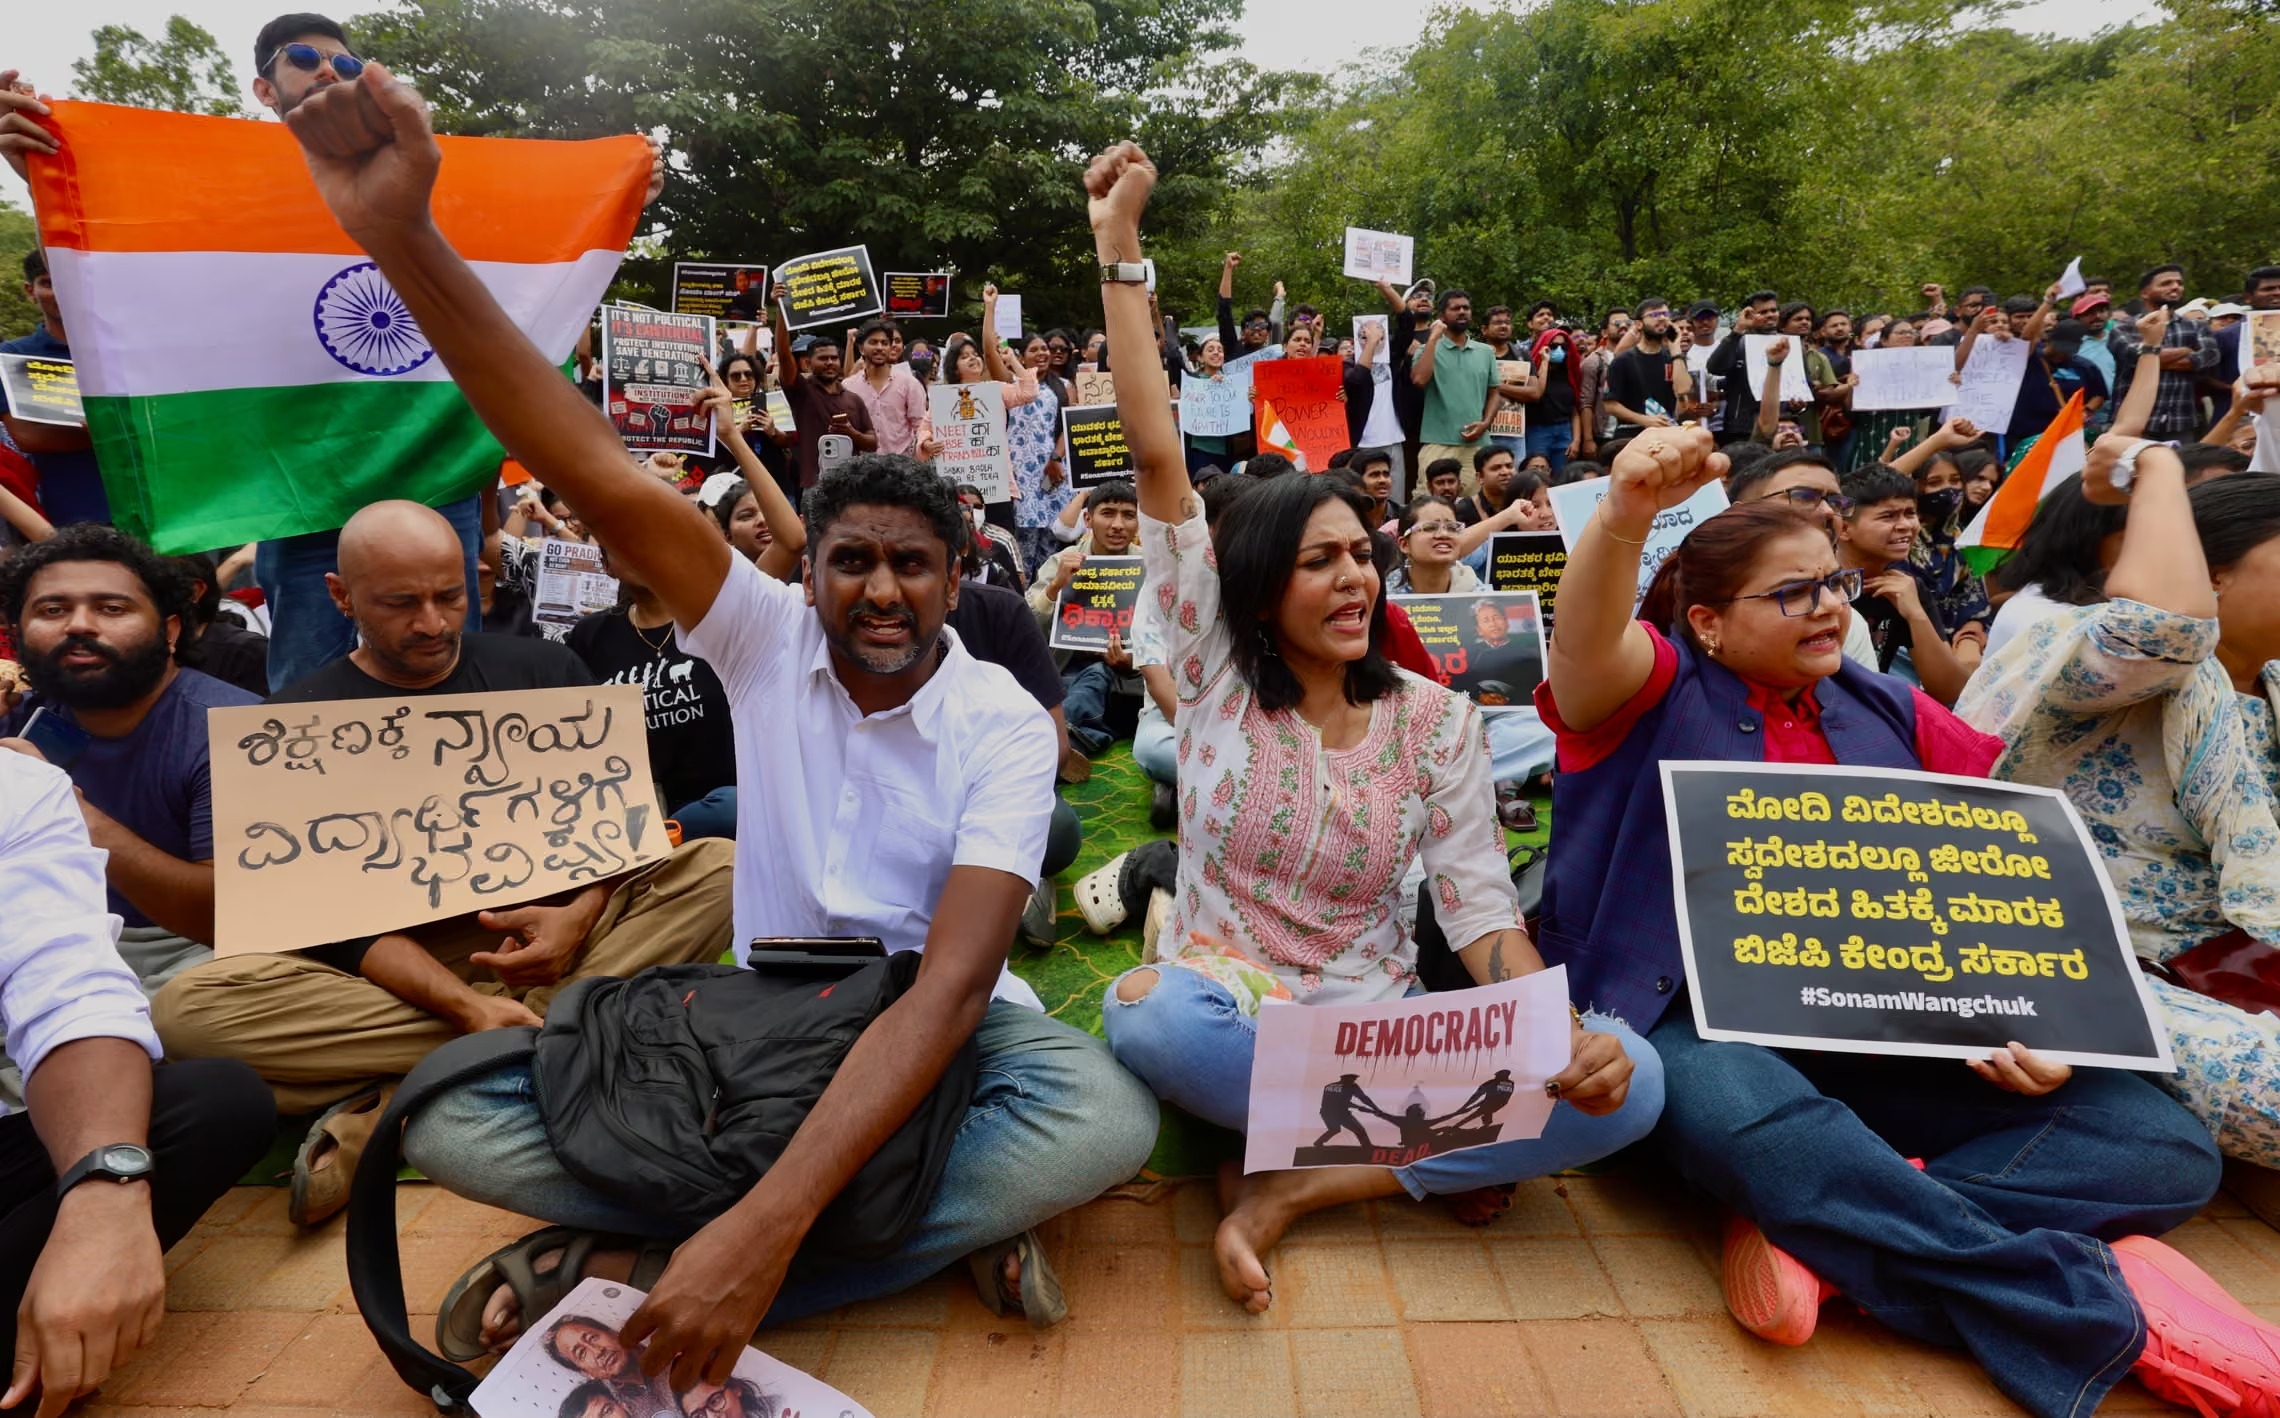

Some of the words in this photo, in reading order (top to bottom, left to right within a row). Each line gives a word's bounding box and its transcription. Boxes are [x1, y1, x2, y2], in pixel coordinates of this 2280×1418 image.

[632, 312, 651, 324] NOT
[616, 346, 639, 356] SAVE
[1271, 397, 1329, 424] POWER
[935, 424, 967, 438] NEET
[944, 439, 964, 449] BSE
[546, 543, 562, 556] GO
[564, 546, 602, 561] PRADH
[643, 684, 701, 711] TICAL
[645, 703, 704, 730] UTION
[1727, 788, 1832, 822] ಮೋದಿ
[1841, 793, 2038, 844] ವಿದೇಶದಲ್ಲೂ
[1726, 835, 1929, 883] ಸ್ವದೇಶದಲ್ಲೂ
[1929, 843, 2052, 880] ಜೀರೋ
[1734, 881, 1840, 918] ದೇಶದ
[1850, 887, 1949, 935] ಹಿತಕ್ಕೆ
[1947, 892, 2065, 929] ಮಾರಕ
[1733, 932, 1832, 968] ಬಿಜೆಪಿ
[1839, 934, 1955, 983] ಕೇಂದ್ರ
[1958, 943, 2089, 981] ಸರ್ಕಾರ
[1800, 986, 2038, 1018] #SonamWangchuk
[1334, 1000, 1518, 1058] DEMOCRACY
